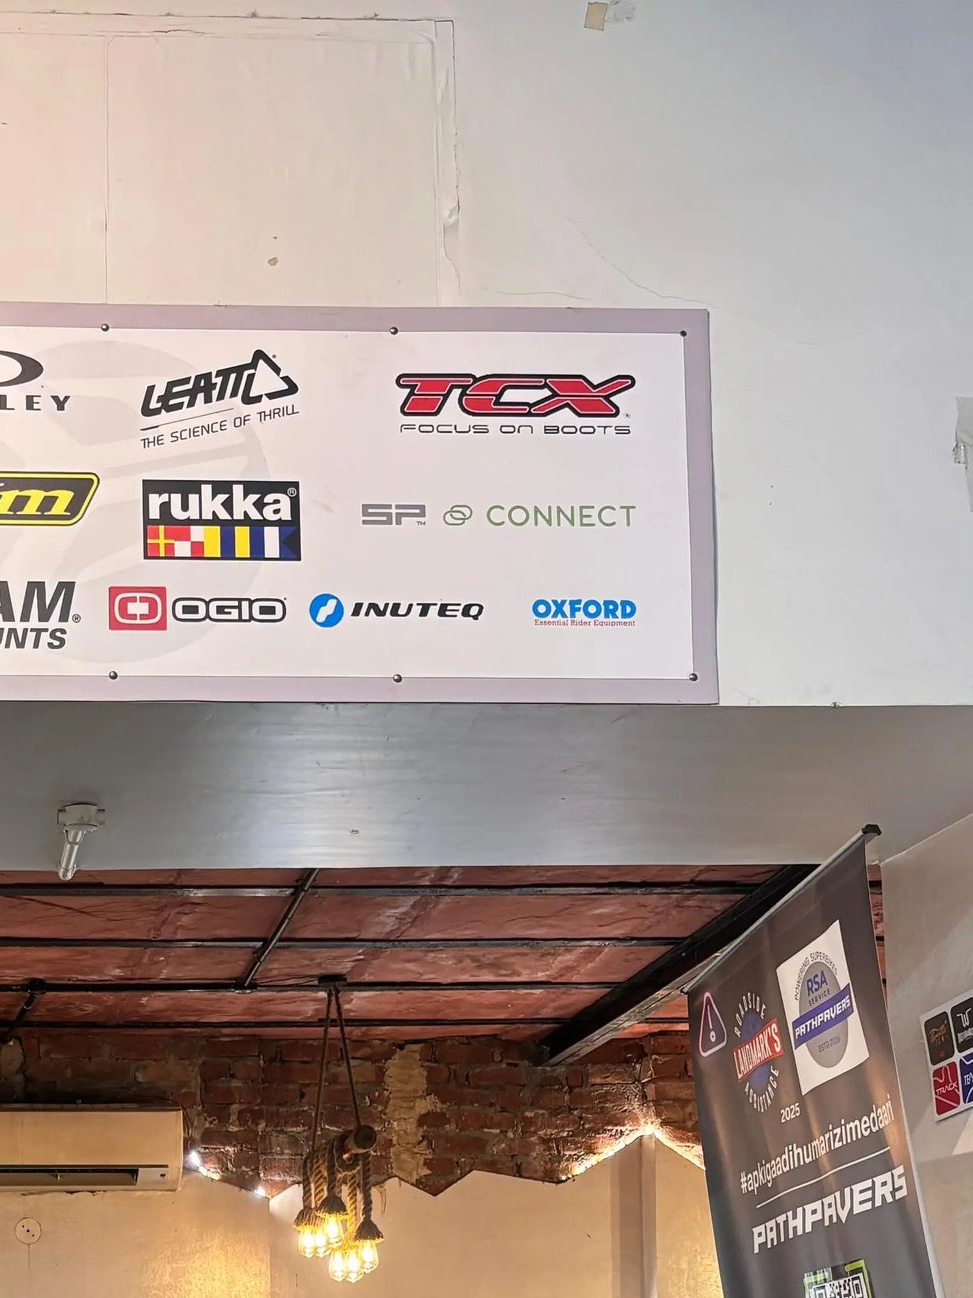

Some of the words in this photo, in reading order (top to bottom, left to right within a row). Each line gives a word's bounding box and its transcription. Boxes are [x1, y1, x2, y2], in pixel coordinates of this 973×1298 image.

[395, 373, 636, 417] TCX
[140, 434, 165, 449] THE
[170, 420, 229, 443] SCIENCE
[233, 414, 251, 428] OF
[257, 404, 300, 423] THRILL
[400, 424, 489, 434] FOCUS
[544, 425, 631, 435] BOOTS
[148, 484, 293, 521] rukka
[361, 503, 426, 526] SP
[486, 504, 636, 527] CONNECT
[172, 597, 287, 623] OGIO
[350, 602, 484, 620] INUTEQ
[532, 599, 637, 619] OXFORD
[593, 619, 636, 628] Equipment
[806, 969, 829, 997] RSA
[808, 988, 831, 1007] SERVICE
[734, 992, 766, 1038] ROADSIDE
[795, 995, 852, 1040] PATHPAVERS
[733, 1022, 782, 1080] LANDMARK'S
[744, 1065, 780, 1113] ASSISTANCE
[780, 1102, 801, 1124] 2025
[752, 1164, 908, 1254] PATHPAVERS
